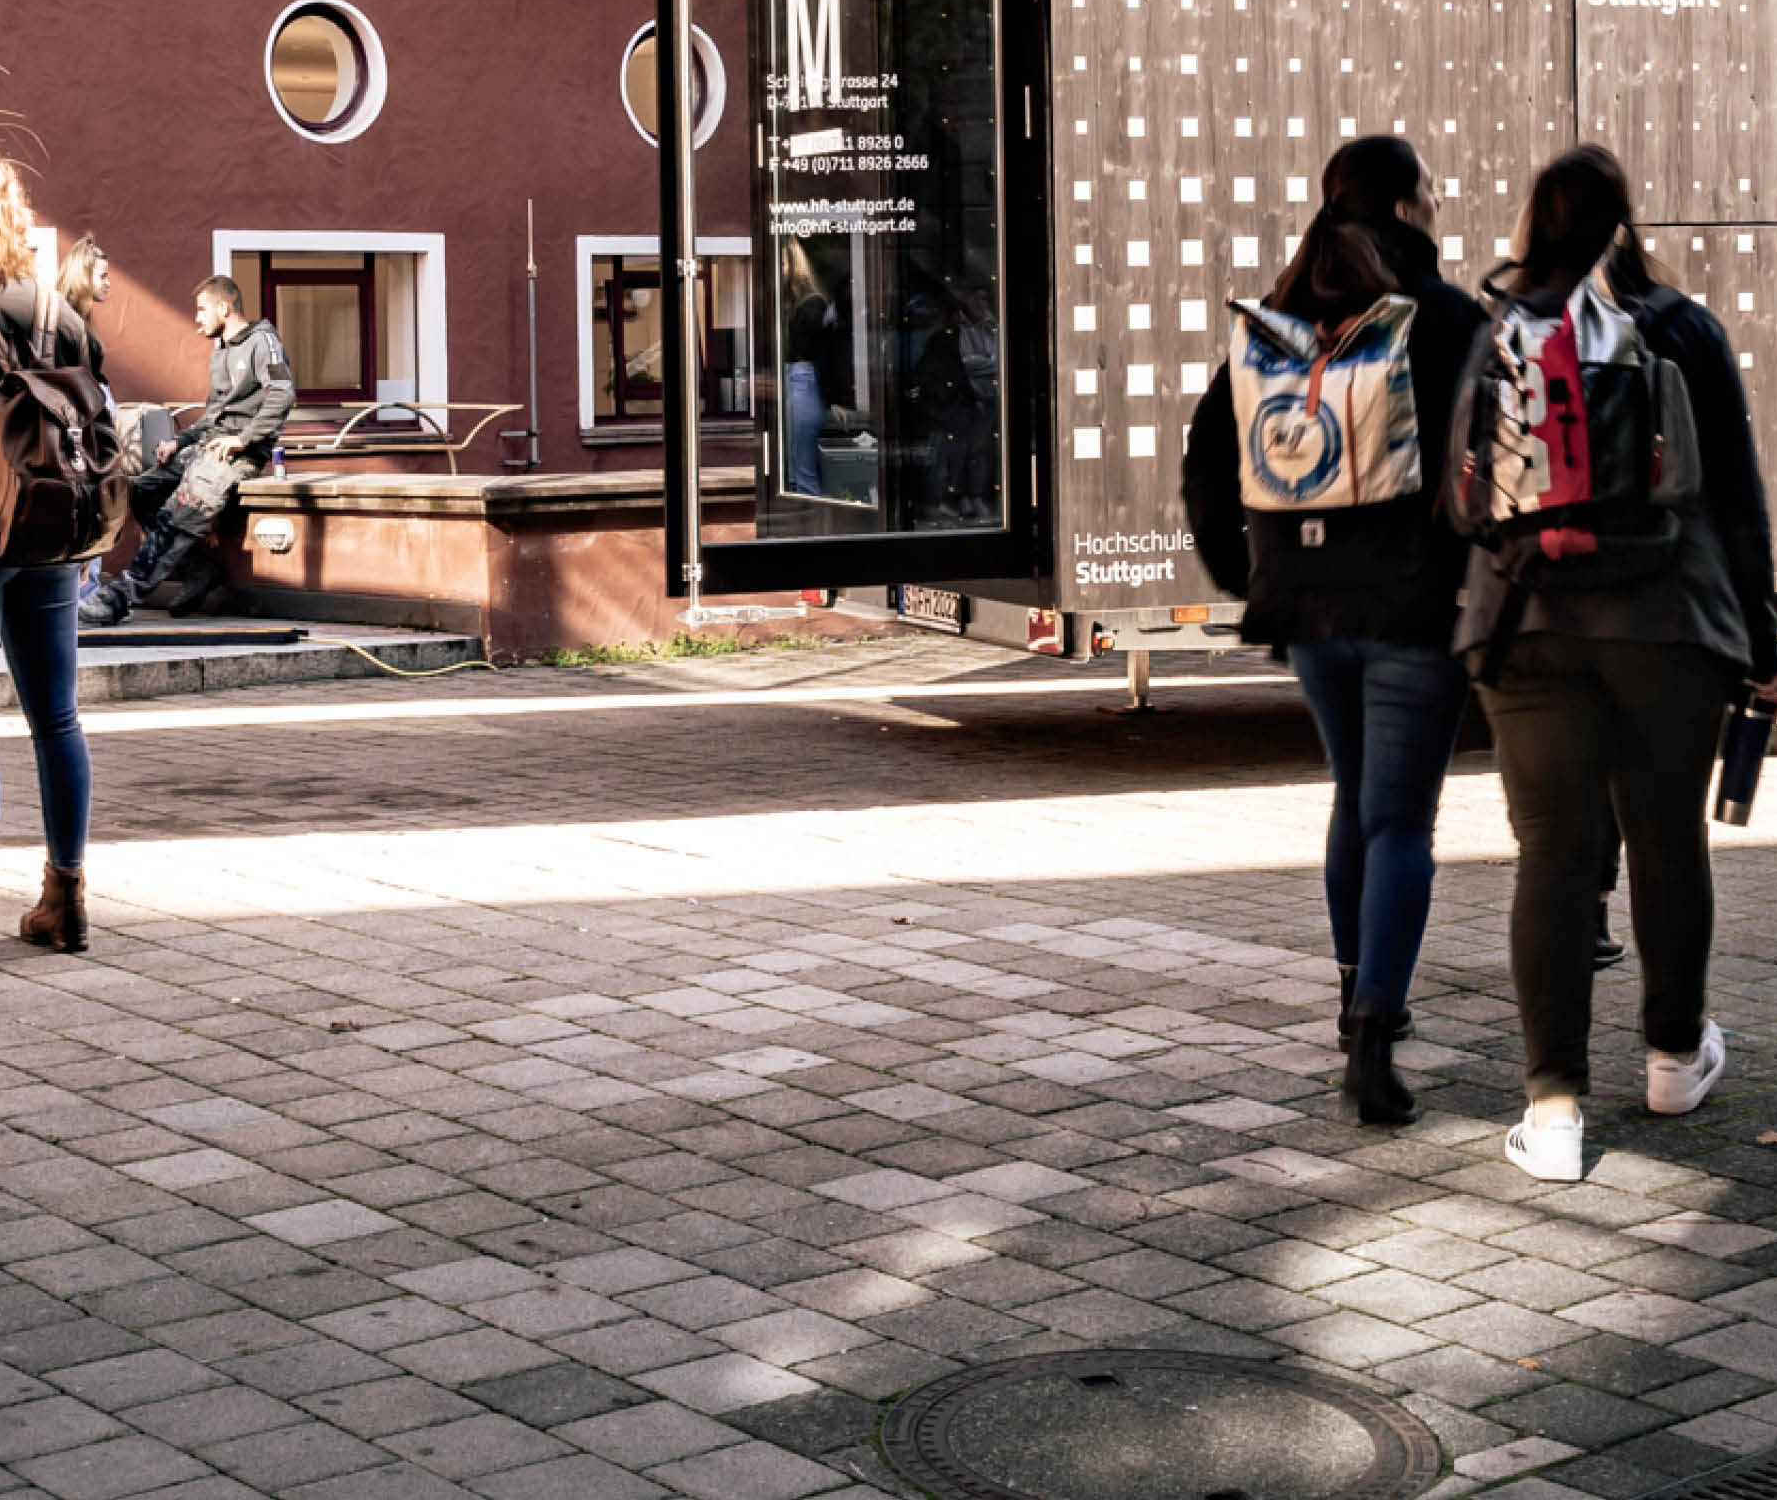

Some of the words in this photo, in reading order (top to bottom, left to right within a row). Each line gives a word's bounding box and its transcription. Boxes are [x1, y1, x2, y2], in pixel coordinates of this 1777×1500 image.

[881, 73, 898, 89] 24
[858, 135, 891, 150] 8926
[895, 135, 904, 150] 0
[782, 157, 809, 171] +49
[858, 156, 891, 171] 8926
[895, 155, 930, 171] 2666
[769, 198, 915, 215] www.hft-stuttgart.de
[769, 217, 916, 237] info@hft-stuttgart.de
[1073, 528, 1195, 555] Hochschule
[1075, 558, 1175, 588] Stuttgart
